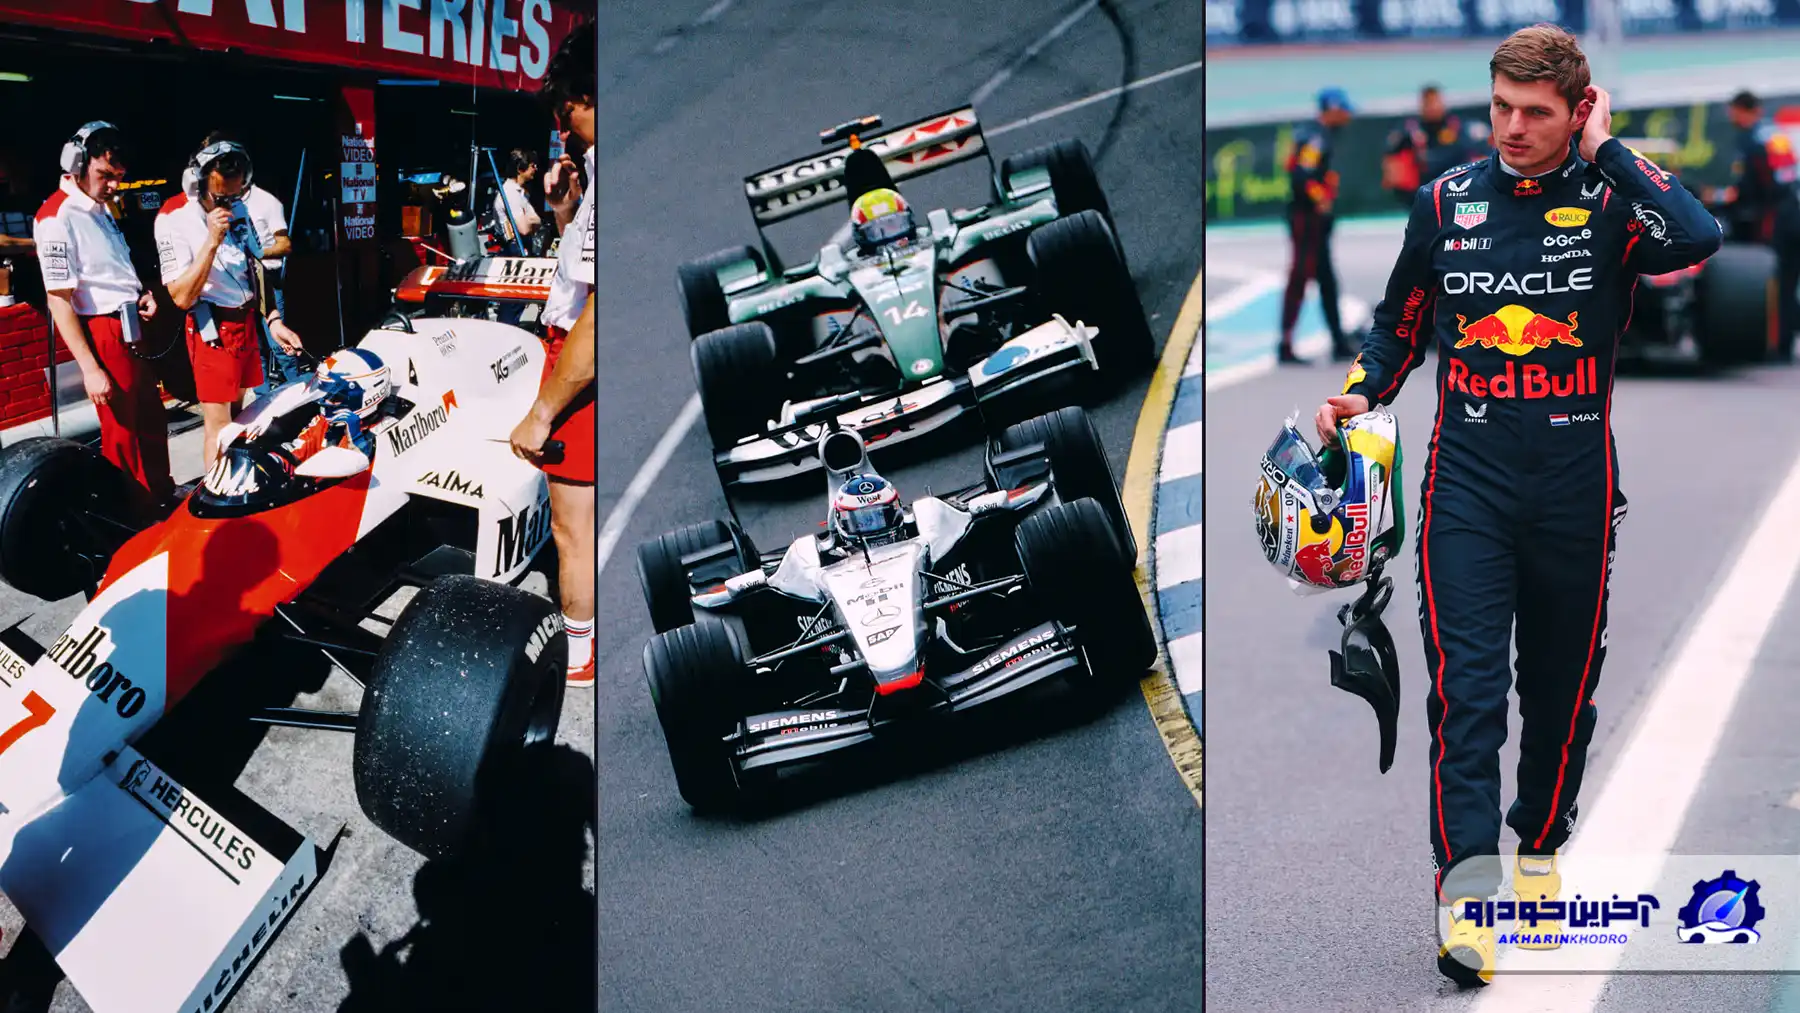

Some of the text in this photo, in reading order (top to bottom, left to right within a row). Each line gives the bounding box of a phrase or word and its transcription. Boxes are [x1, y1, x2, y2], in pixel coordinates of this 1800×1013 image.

[342, 134, 374, 148] National
[344, 148, 374, 161] VIDEO
[343, 176, 374, 187] National
[1634, 159, 1654, 177] Red
[1650, 173, 1671, 192] Bull
[353, 188, 367, 200] TV
[344, 214, 375, 227] National
[1460, 204, 1486, 213] TAG
[346, 226, 374, 240] VIDEO
[1444, 238, 1492, 251] Mobil 1
[1541, 249, 1593, 263] HONDA
[1443, 267, 1594, 295] ORACLE
[883, 300, 929, 327] 14
[1402, 286, 1425, 321] WINGS
[490, 358, 509, 384] TAG
[1448, 356, 1597, 399] Red Bull
[1572, 412, 1600, 422] MAX
[387, 405, 447, 458] Marlboro
[857, 493, 882, 504] West
[1282, 528, 1293, 566] Heineken
[1339, 503, 1368, 581] Red Bull
[868, 628, 896, 646] SAP
[0, 646, 26, 680] ULES
[972, 630, 1055, 675] SIEMENS
[1005, 641, 1059, 668] mobile
[46, 624, 146, 718] arlboro
[0, 690, 57, 756] 7
[749, 710, 838, 733] SIEMENS
[780, 722, 839, 735] mobile
[149, 776, 256, 870] HERCULES
[194, 874, 305, 1013] ICHELIN
